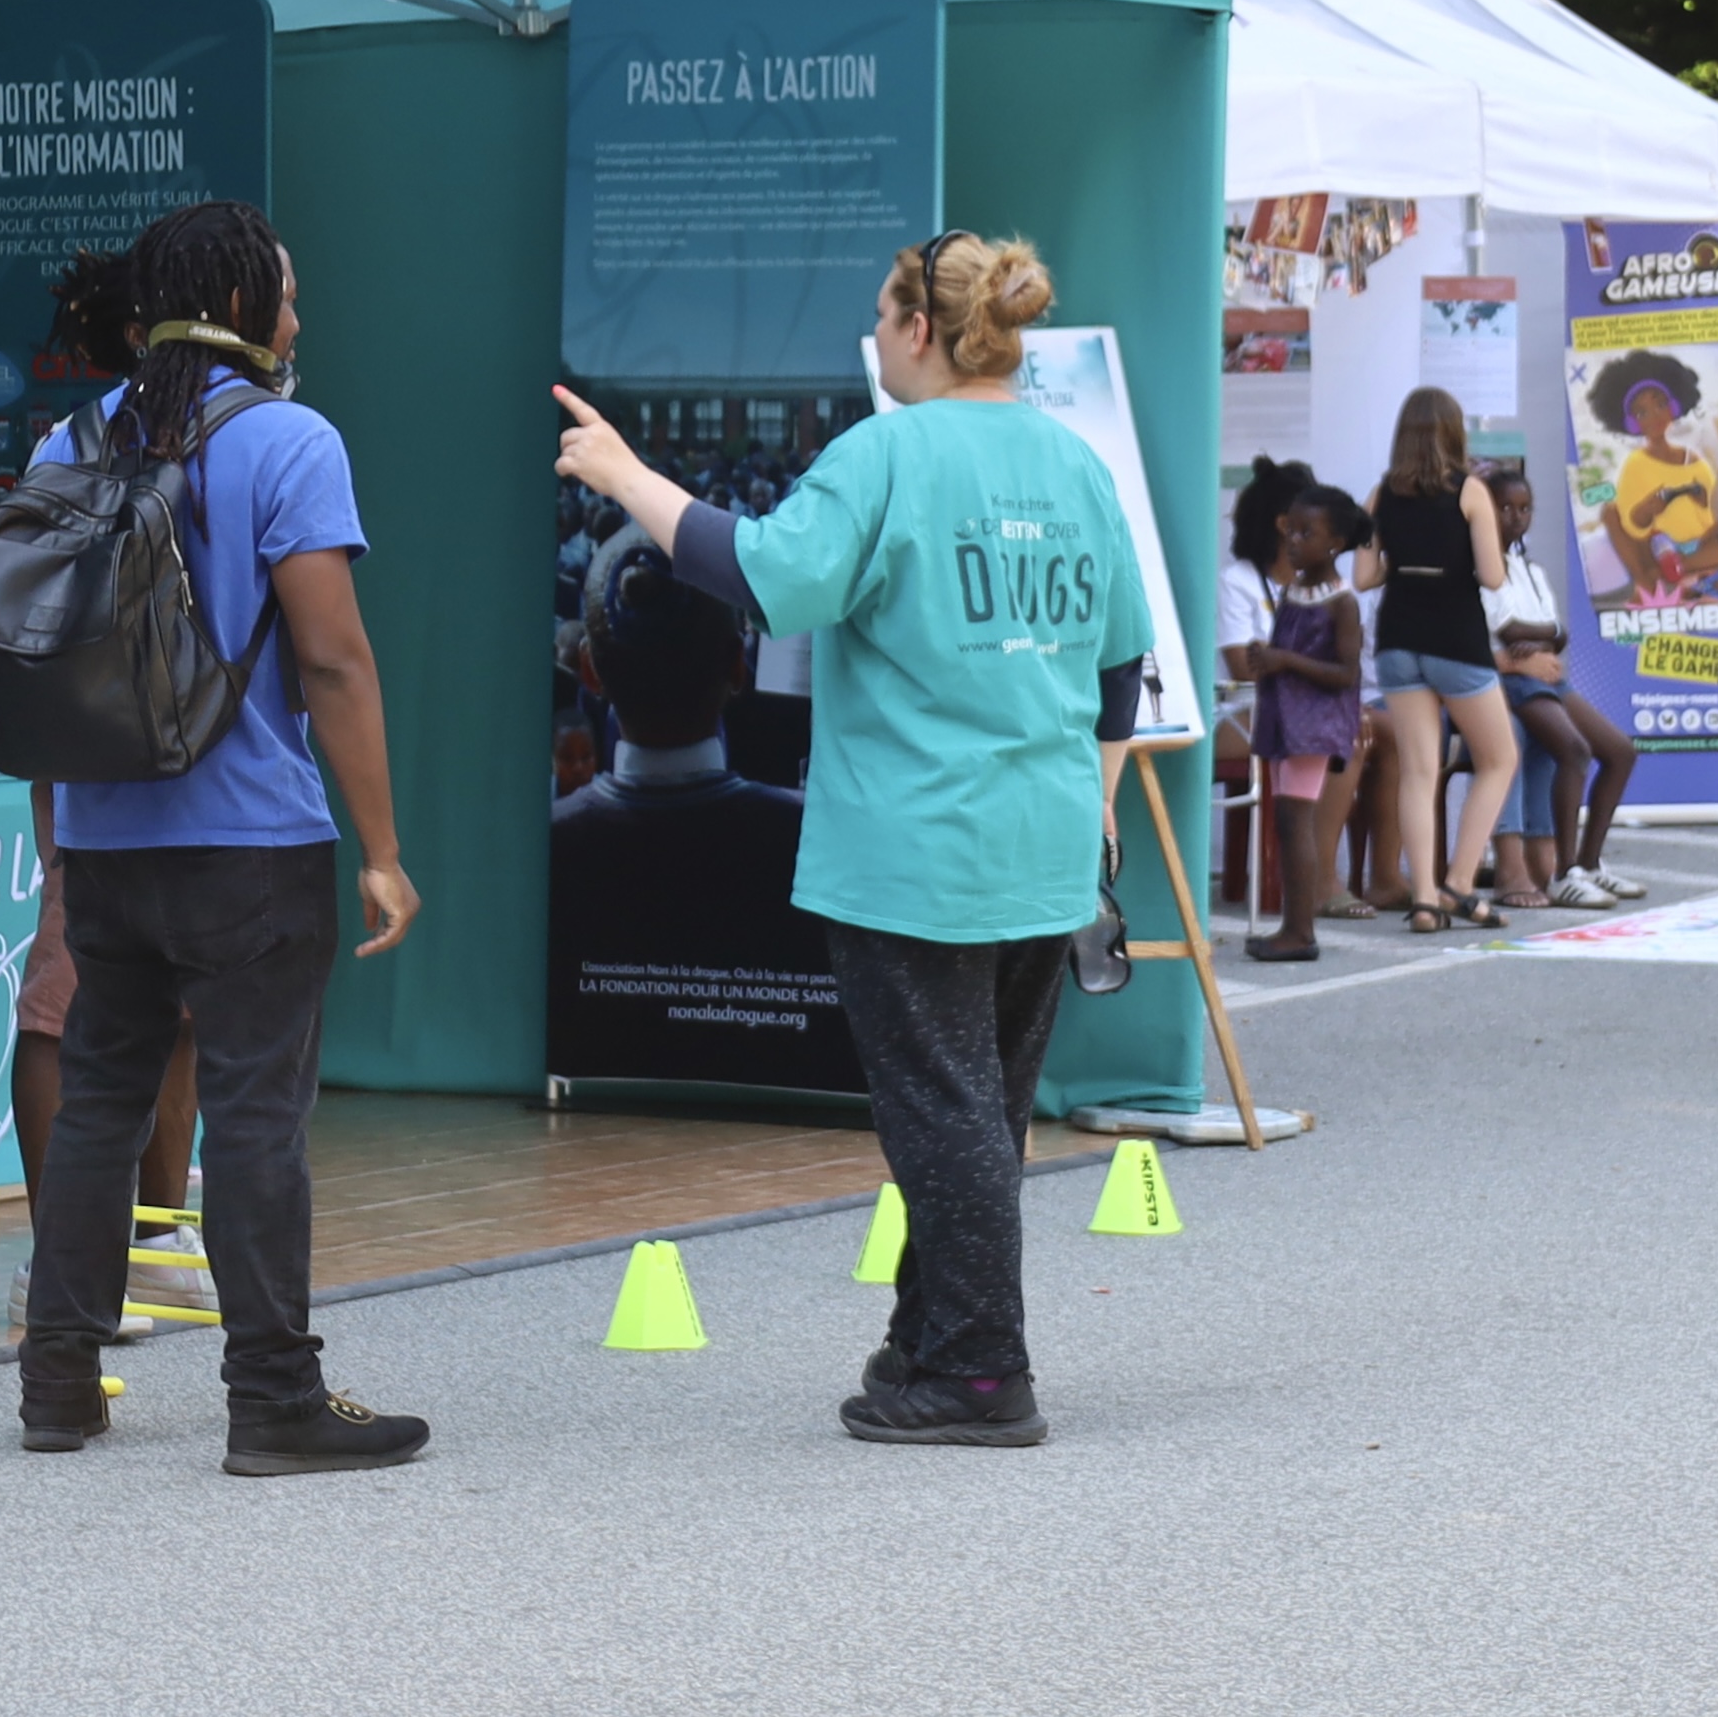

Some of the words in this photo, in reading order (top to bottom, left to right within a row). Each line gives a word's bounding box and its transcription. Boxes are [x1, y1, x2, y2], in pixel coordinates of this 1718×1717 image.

[627, 58, 724, 104] PASSEZ
[735, 50, 753, 102] À
[763, 54, 877, 103] L'ACTION
[73, 77, 178, 121] MISSION
[88, 194, 107, 209] LA
[109, 189, 159, 208] VÉRITÉ
[162, 191, 192, 206] SUR
[40, 216, 79, 231] C'EST
[83, 213, 127, 230] FACILE
[131, 211, 143, 229] À
[62, 237, 100, 254] C'EST
[104, 235, 137, 251] GRA
[1623, 251, 1693, 278] AFRO
[1043, 521, 1081, 539] OVER
[1644, 654, 1666, 670] LE
[733, 967, 754, 979] Oui
[579, 978, 597, 992] LA
[600, 979, 679, 995] FONDATION
[682, 983, 719, 998] POUR
[722, 985, 743, 998] UN
[745, 986, 798, 1002] MONDE
[802, 989, 839, 1004] SANS
[667, 1003, 807, 1030] nonaladrogue.org
